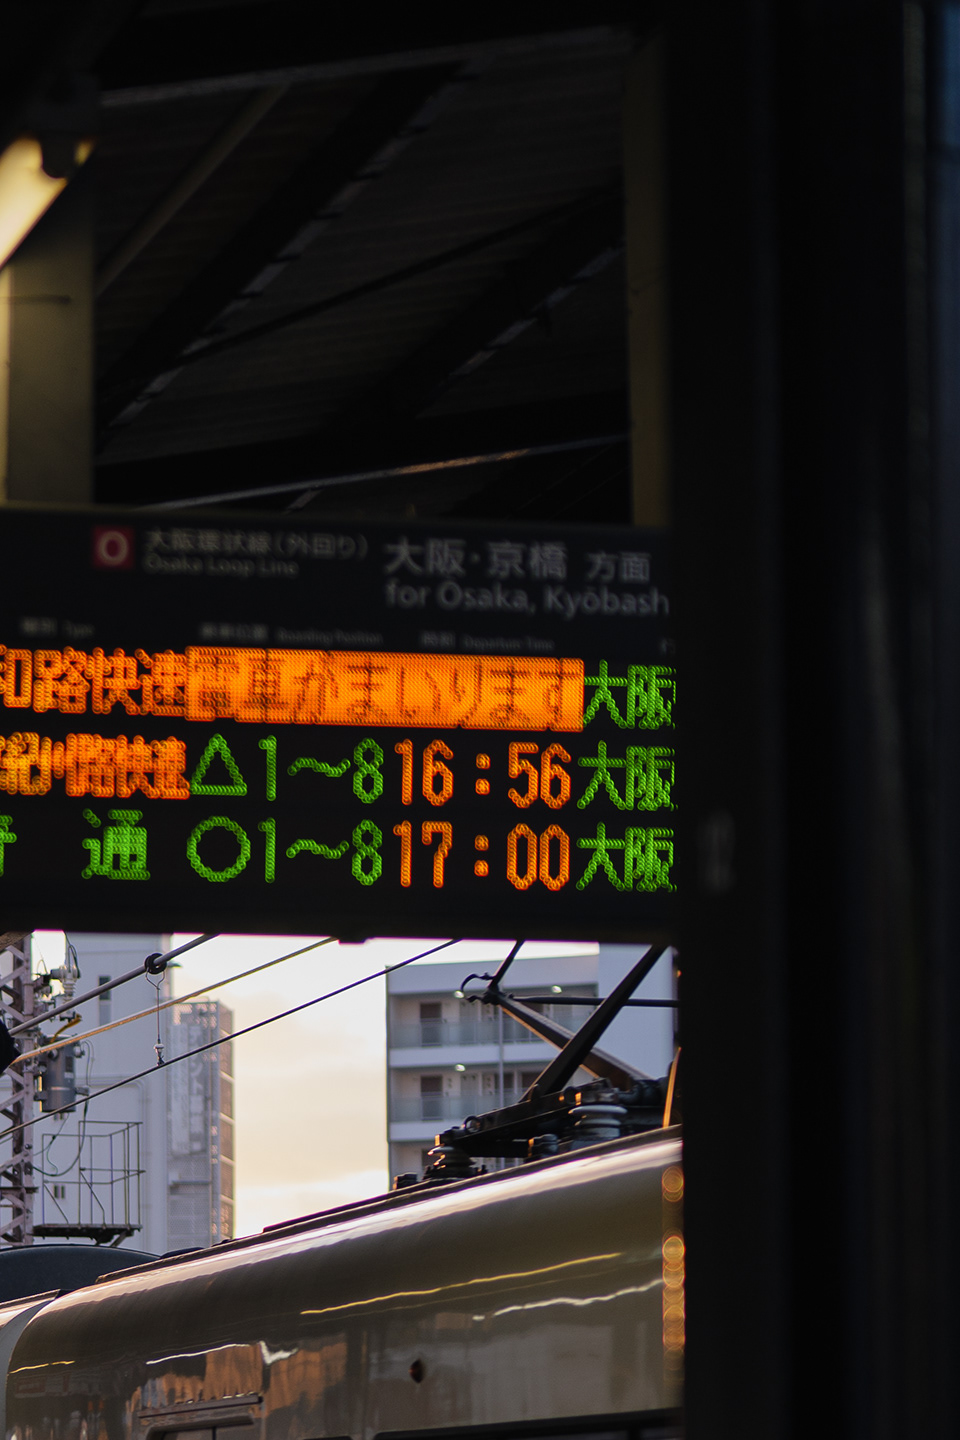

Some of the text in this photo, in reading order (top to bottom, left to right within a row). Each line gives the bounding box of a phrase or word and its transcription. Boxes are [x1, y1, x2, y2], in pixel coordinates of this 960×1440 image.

[257, 559, 299, 579] Line
[385, 577, 431, 609] for
[587, 551, 652, 584] 方面
[187, 648, 584, 732] 電車がまいります
[584, 659, 678, 729] 大阪
[394, 739, 572, 810] 16:56
[577, 740, 680, 811] 大阪
[393, 820, 571, 892] 17:00
[576, 822, 678, 892] 大阪
